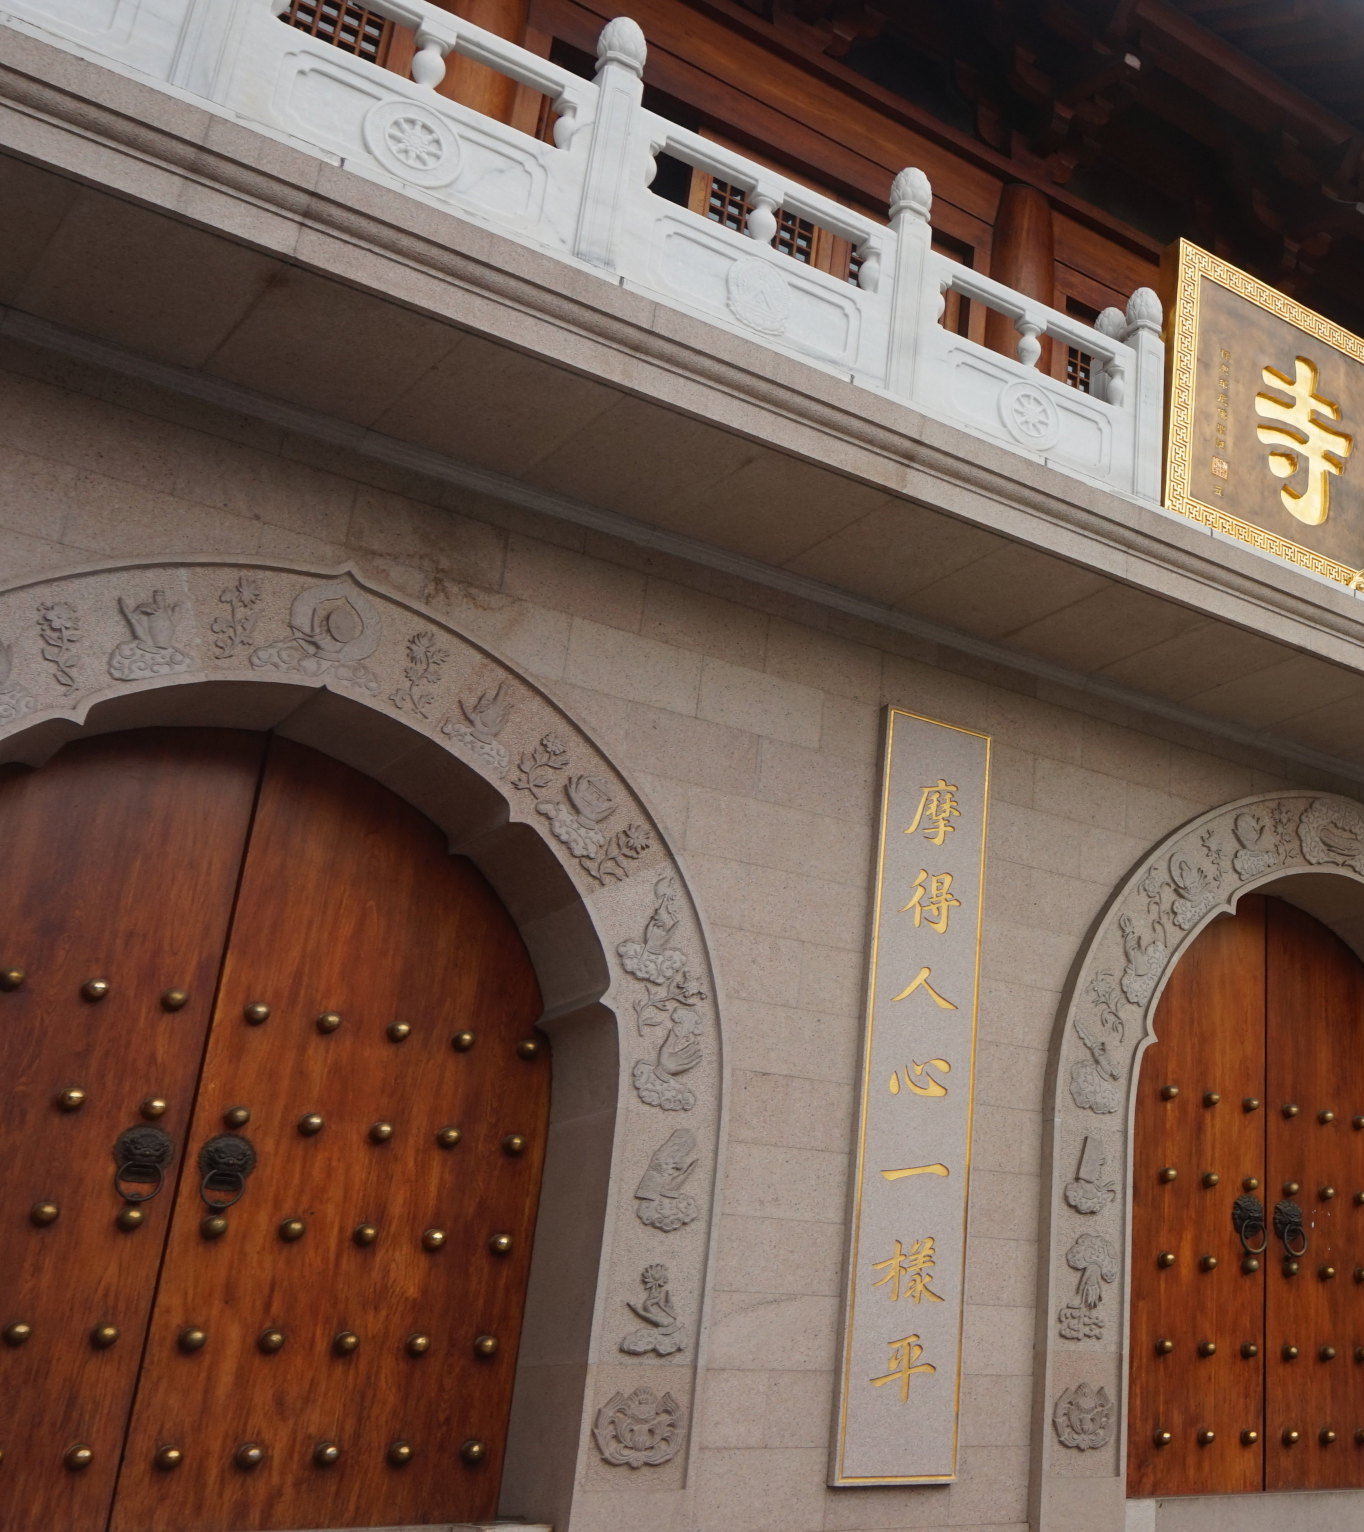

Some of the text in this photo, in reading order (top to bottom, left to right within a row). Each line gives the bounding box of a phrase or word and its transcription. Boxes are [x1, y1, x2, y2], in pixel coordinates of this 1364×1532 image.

[869, 778, 963, 1405] 摩得人心一樣平
